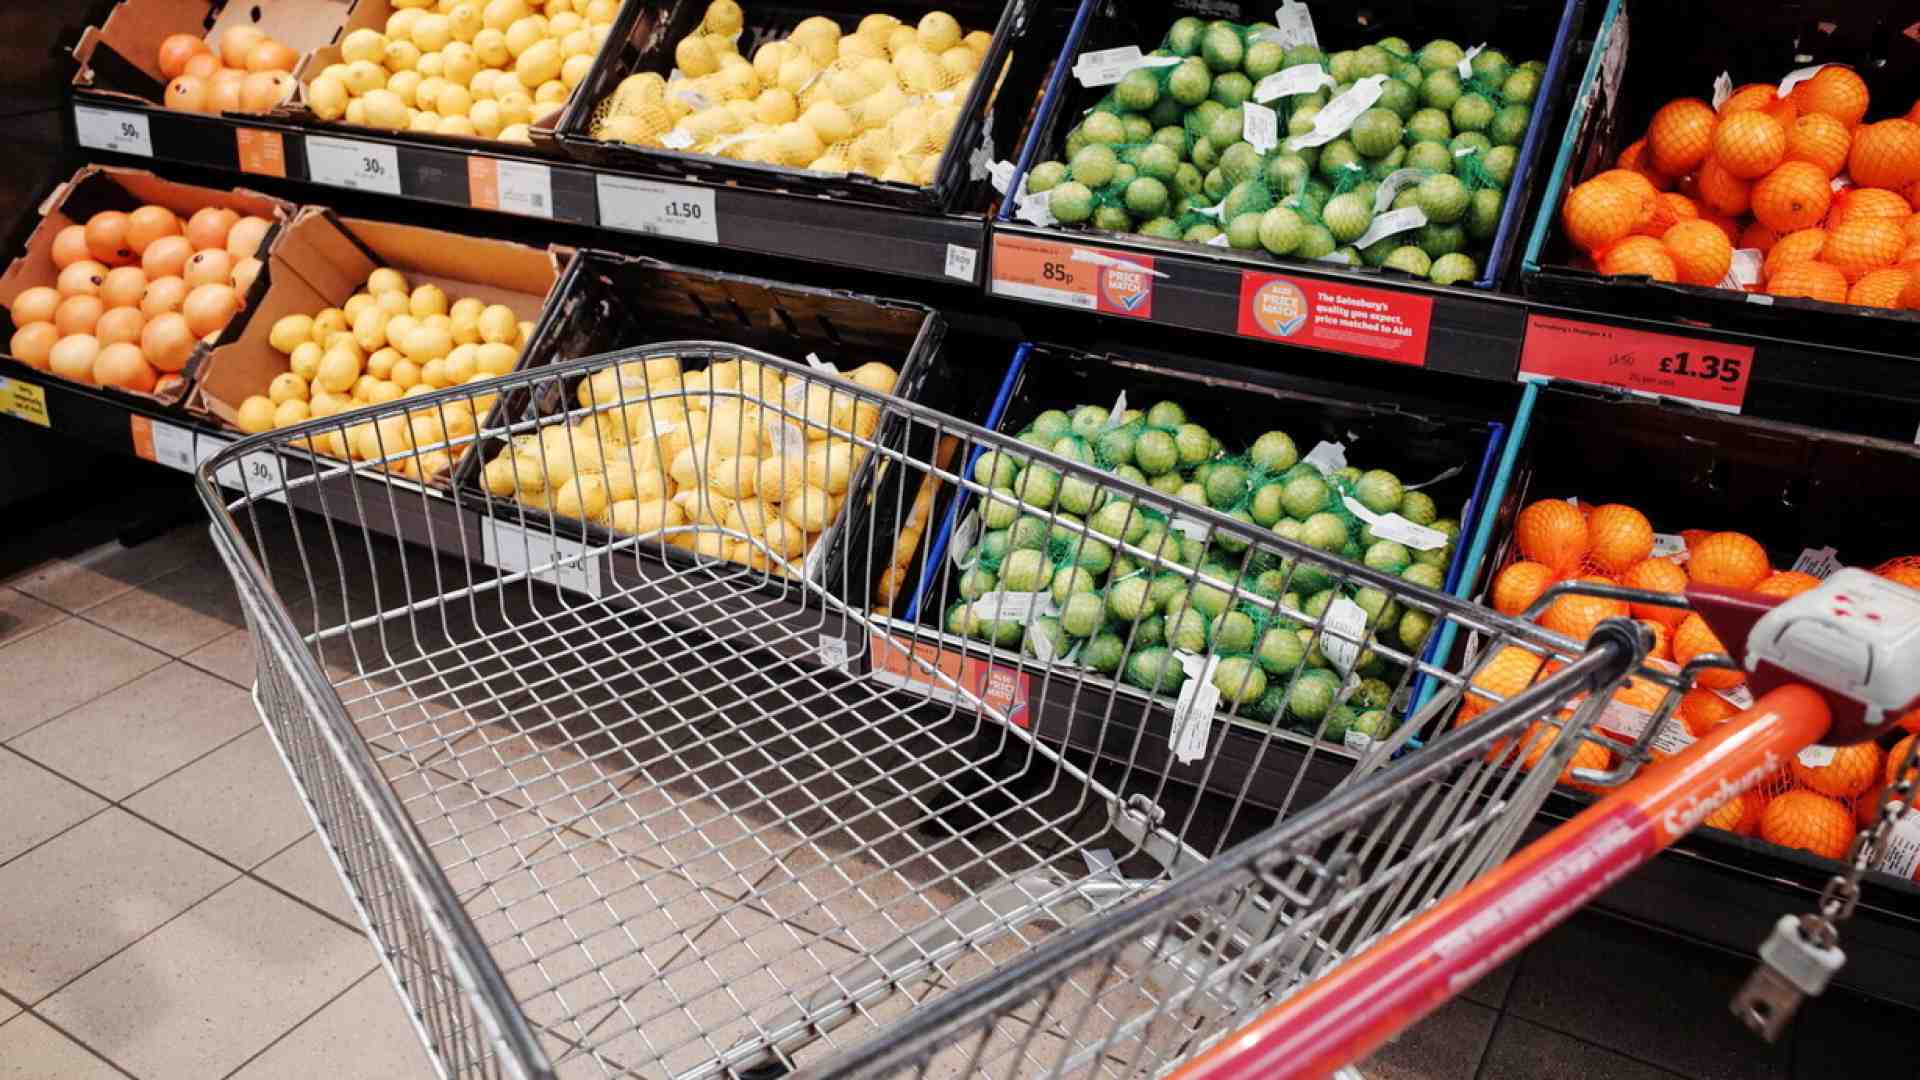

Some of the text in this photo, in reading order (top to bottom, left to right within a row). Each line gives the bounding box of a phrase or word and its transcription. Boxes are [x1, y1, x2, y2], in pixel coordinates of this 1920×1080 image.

[665, 201, 702, 219] £1.50
[1043, 262, 1073, 285] 85p
[1263, 294, 1298, 305] PRICE
[1318, 292, 1334, 302] The
[1316, 304, 1349, 318] quality
[1350, 310, 1368, 320] you
[1314, 314, 1338, 325] price
[1339, 317, 1380, 331] matched
[1381, 324, 1392, 333] to
[1658, 352, 1742, 383] £1.35
